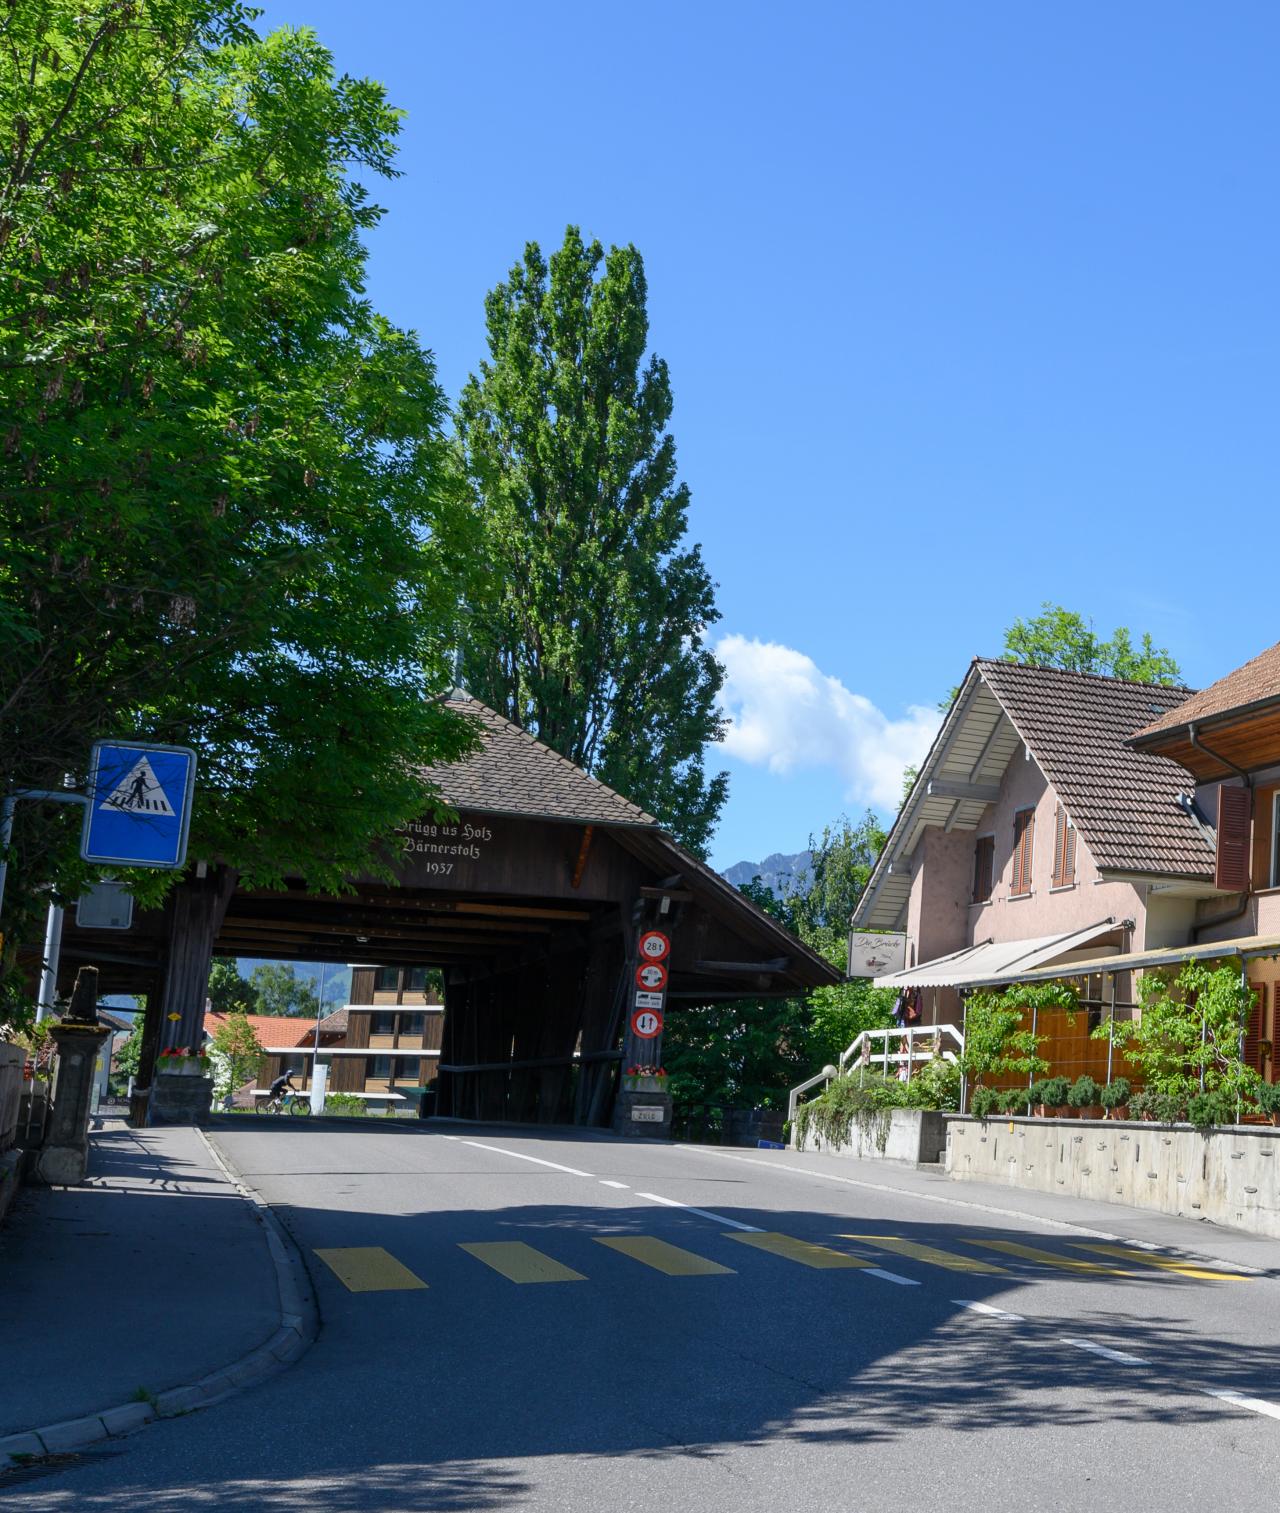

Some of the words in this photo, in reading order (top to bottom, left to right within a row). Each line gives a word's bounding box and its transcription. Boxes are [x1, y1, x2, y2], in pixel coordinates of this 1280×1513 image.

[442, 826, 458, 836] us
[461, 823, 492, 841] Holz
[402, 836, 481, 859] Bärnerstolz
[646, 942, 657, 951] 28
